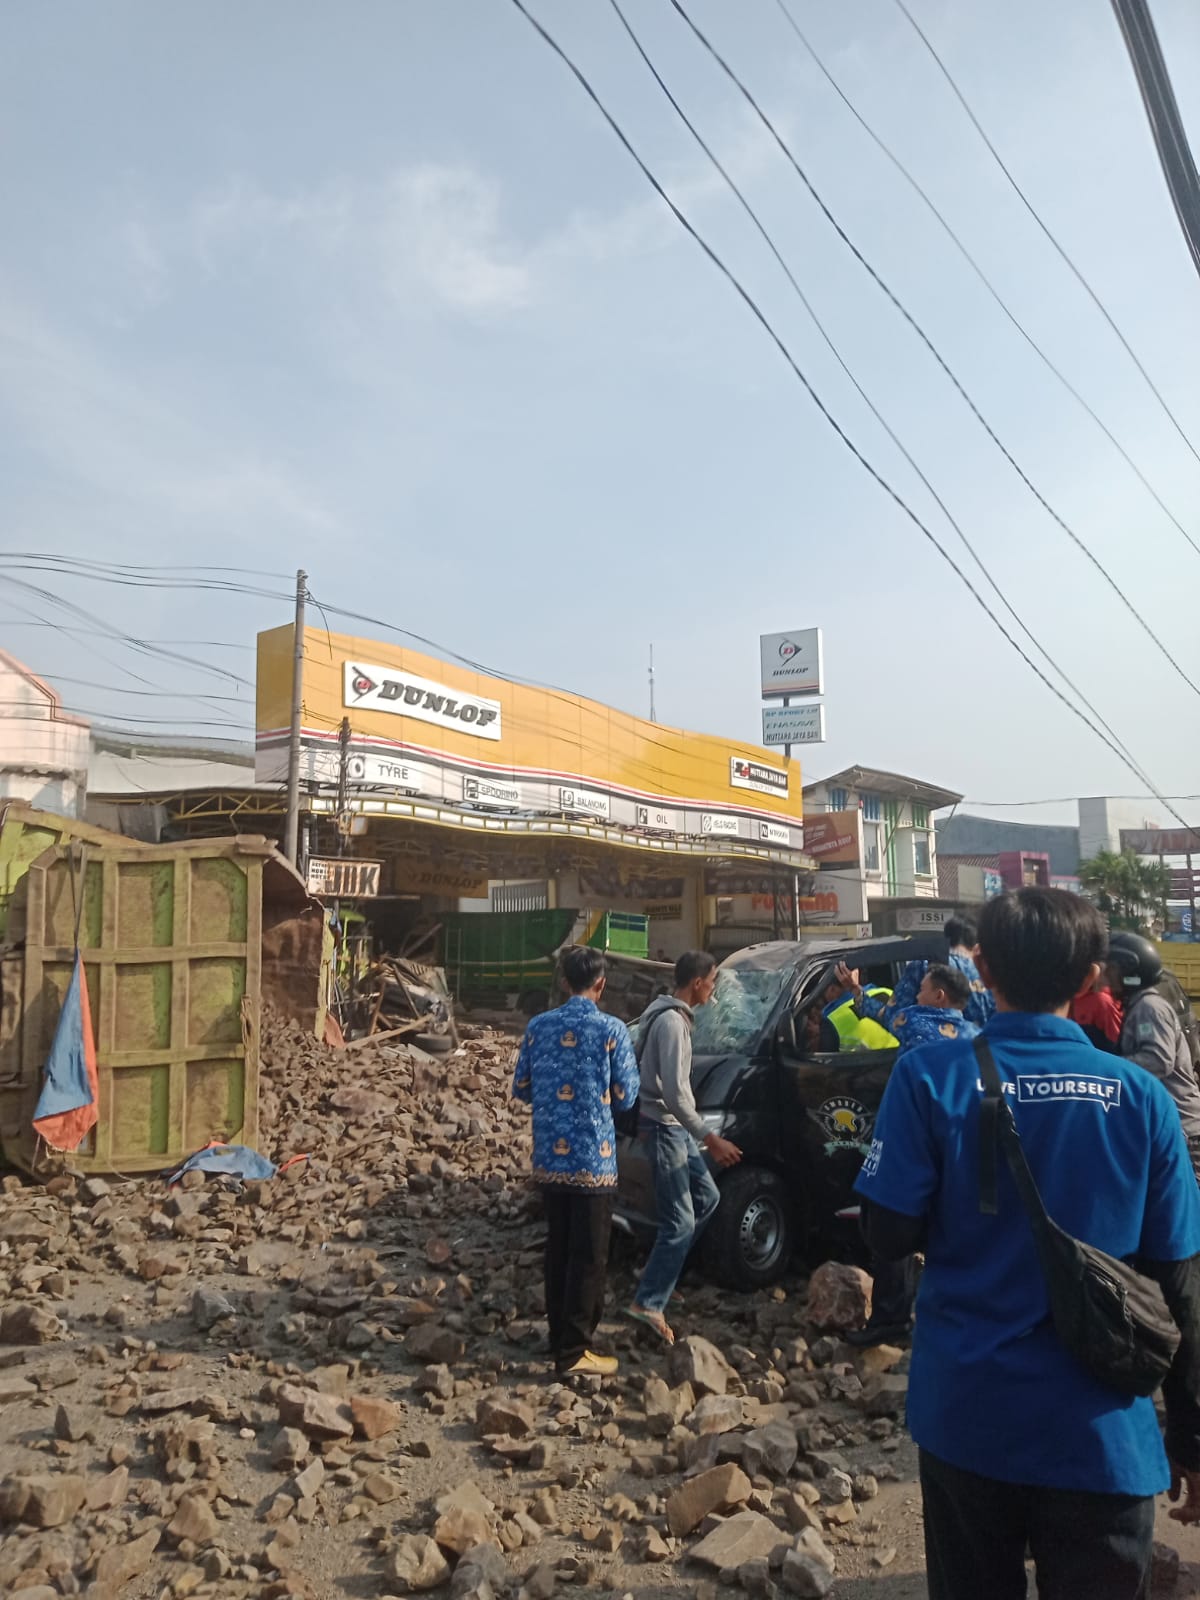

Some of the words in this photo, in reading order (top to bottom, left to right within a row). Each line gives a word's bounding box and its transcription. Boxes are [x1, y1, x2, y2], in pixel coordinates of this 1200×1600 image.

[773, 667, 809, 677] DUNLOP
[376, 679, 498, 727] DUNLOP
[378, 764, 409, 780] TYRE
[577, 797, 607, 811] BALANCING
[656, 814, 668, 824] OIL
[921, 912, 944, 921] ISSI
[976, 1078, 1016, 1094] LVE
[1025, 1080, 1115, 1098] YOURSELF
